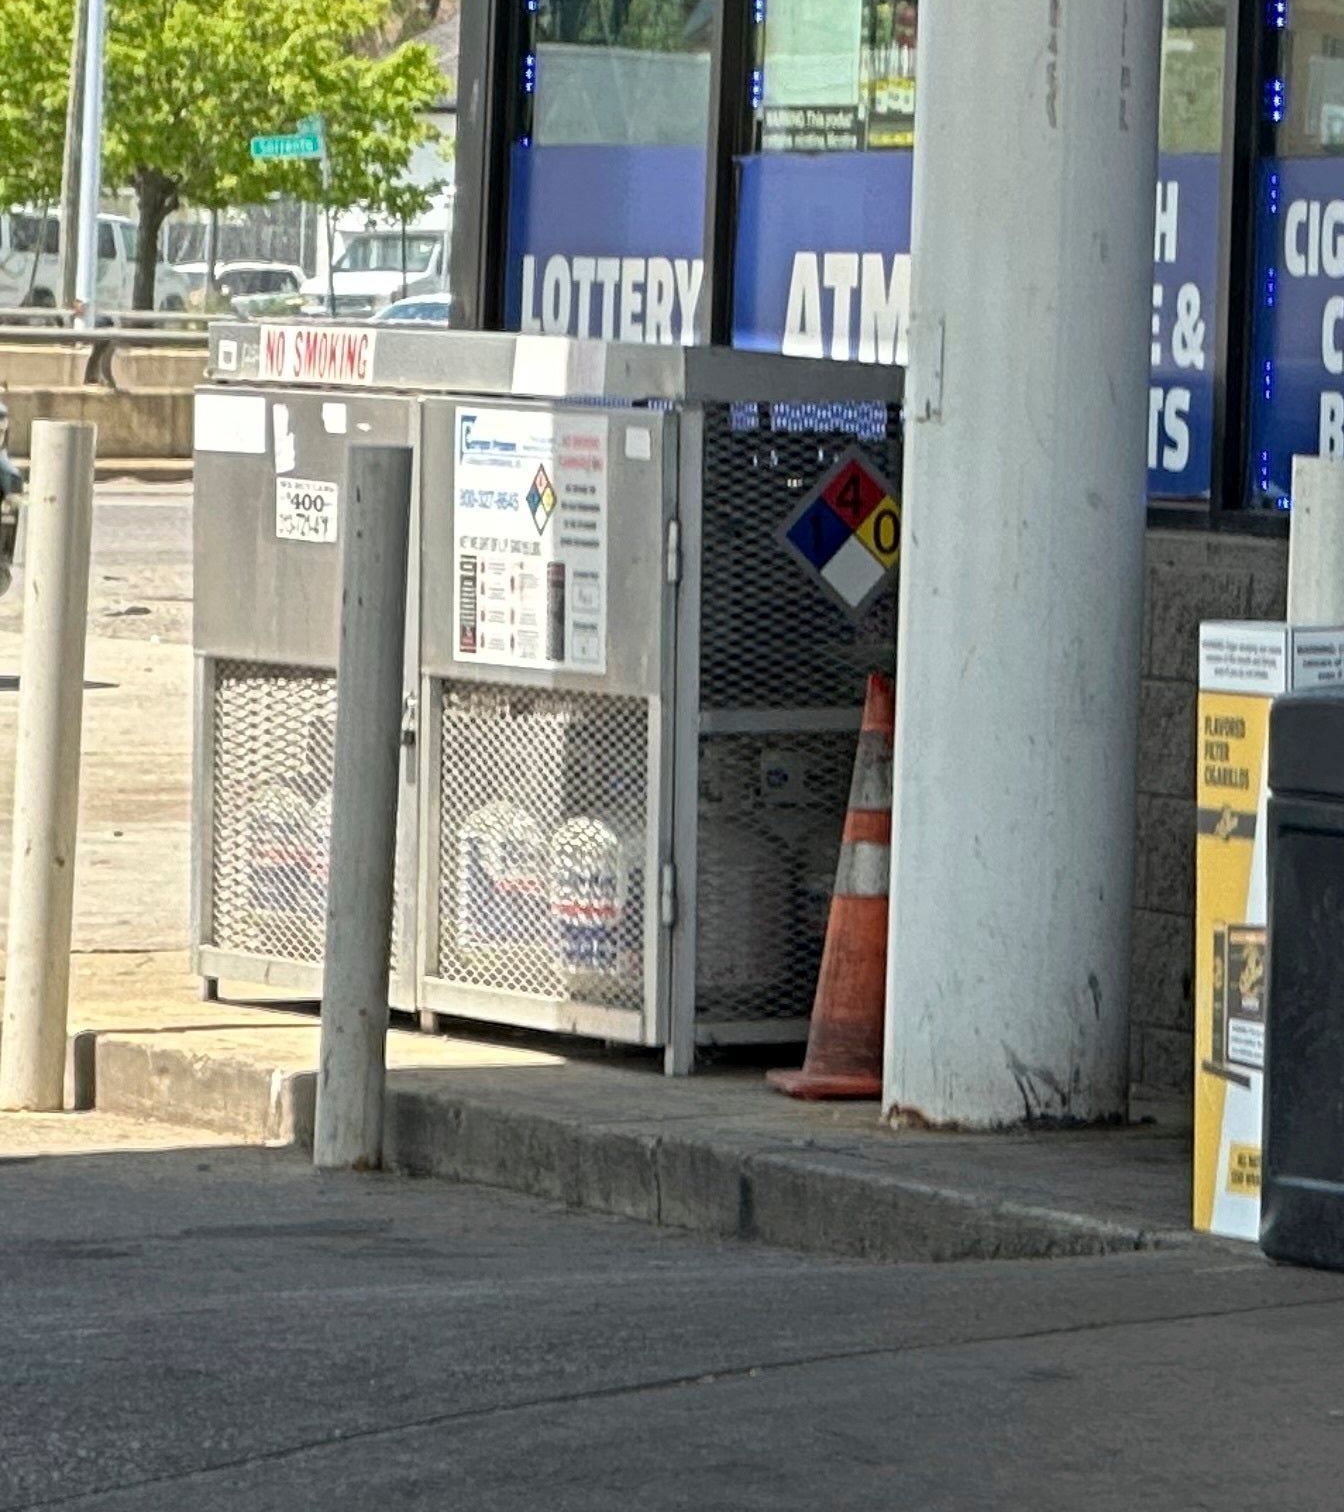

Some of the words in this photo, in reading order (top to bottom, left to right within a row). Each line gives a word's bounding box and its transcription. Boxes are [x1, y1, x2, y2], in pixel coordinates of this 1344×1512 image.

[523, 253, 704, 346] LOTTERY
[783, 251, 911, 366] ATM
[1172, 282, 1205, 370] &
[266, 330, 286, 377] NO
[294, 330, 369, 380] SMOKING
[836, 472, 863, 516] 4
[873, 508, 900, 555] 0
[1205, 715, 1246, 738] FLAVORED
[1204, 740, 1230, 762] FILTER
